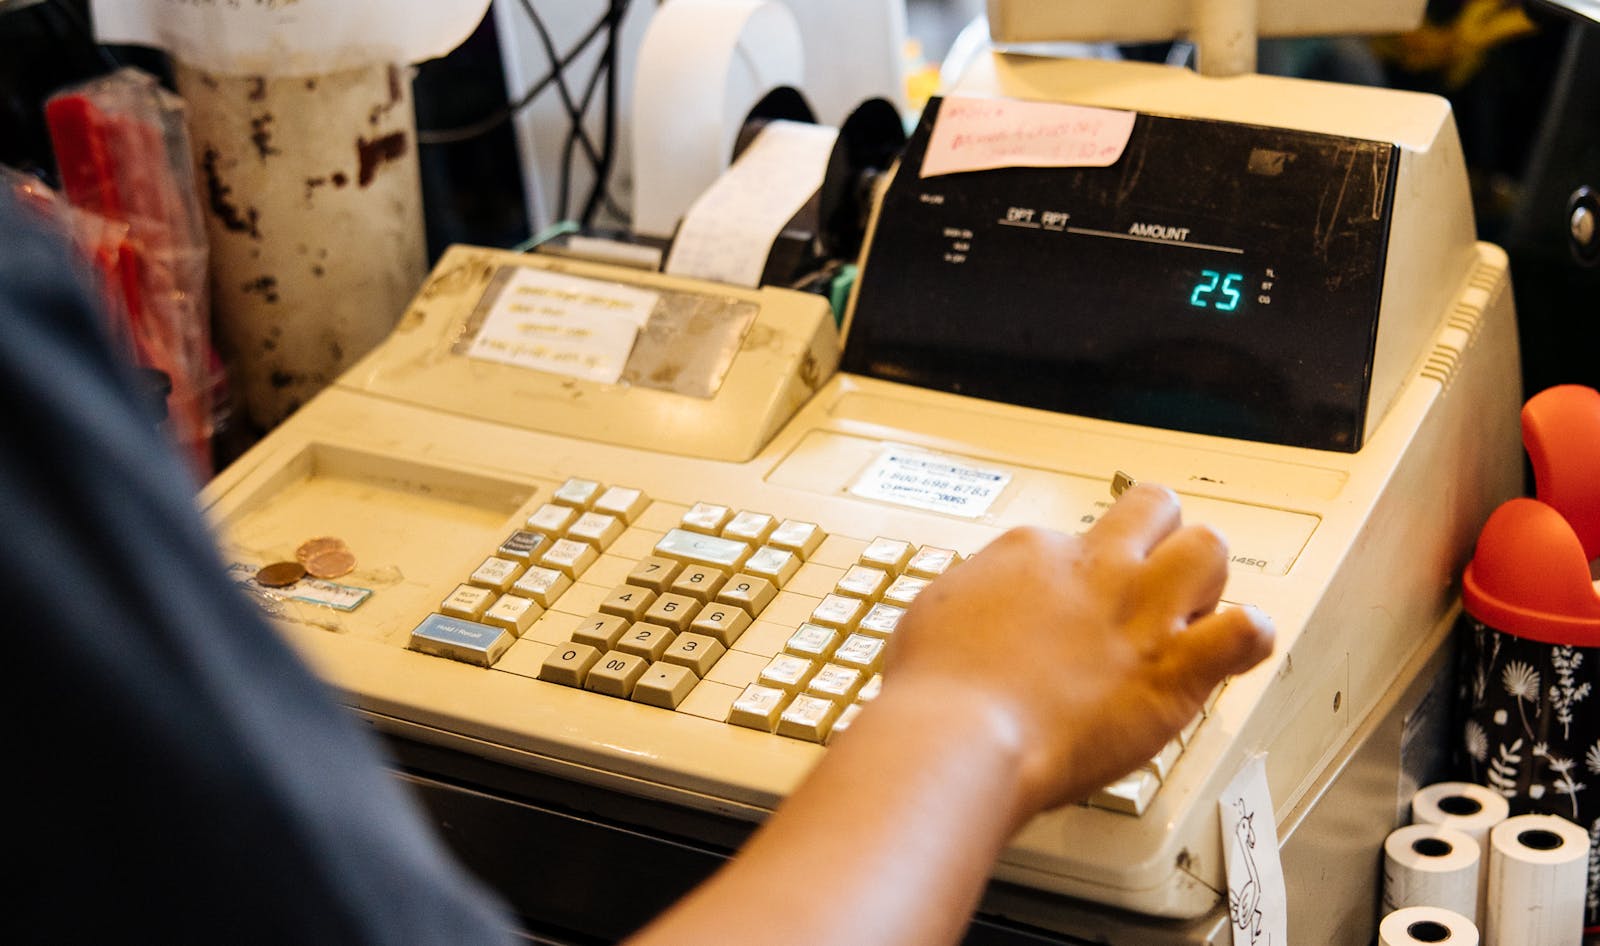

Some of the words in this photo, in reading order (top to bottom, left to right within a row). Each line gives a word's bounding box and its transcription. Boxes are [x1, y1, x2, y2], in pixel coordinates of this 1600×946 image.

[1007, 207, 1036, 223] DPT
[1041, 211, 1070, 227] RPT
[1128, 222, 1190, 242] AMOUNT
[1189, 269, 1243, 312] 25
[645, 564, 661, 573] 7
[690, 573, 705, 583] 8
[736, 583, 751, 594] 9
[619, 593, 633, 602] 4
[663, 602, 680, 612] 5
[710, 612, 726, 622] 6
[595, 621, 604, 632] 1
[635, 631, 652, 641] 2
[682, 641, 698, 652] 3
[562, 650, 577, 661] 0
[606, 659, 626, 671] 00
